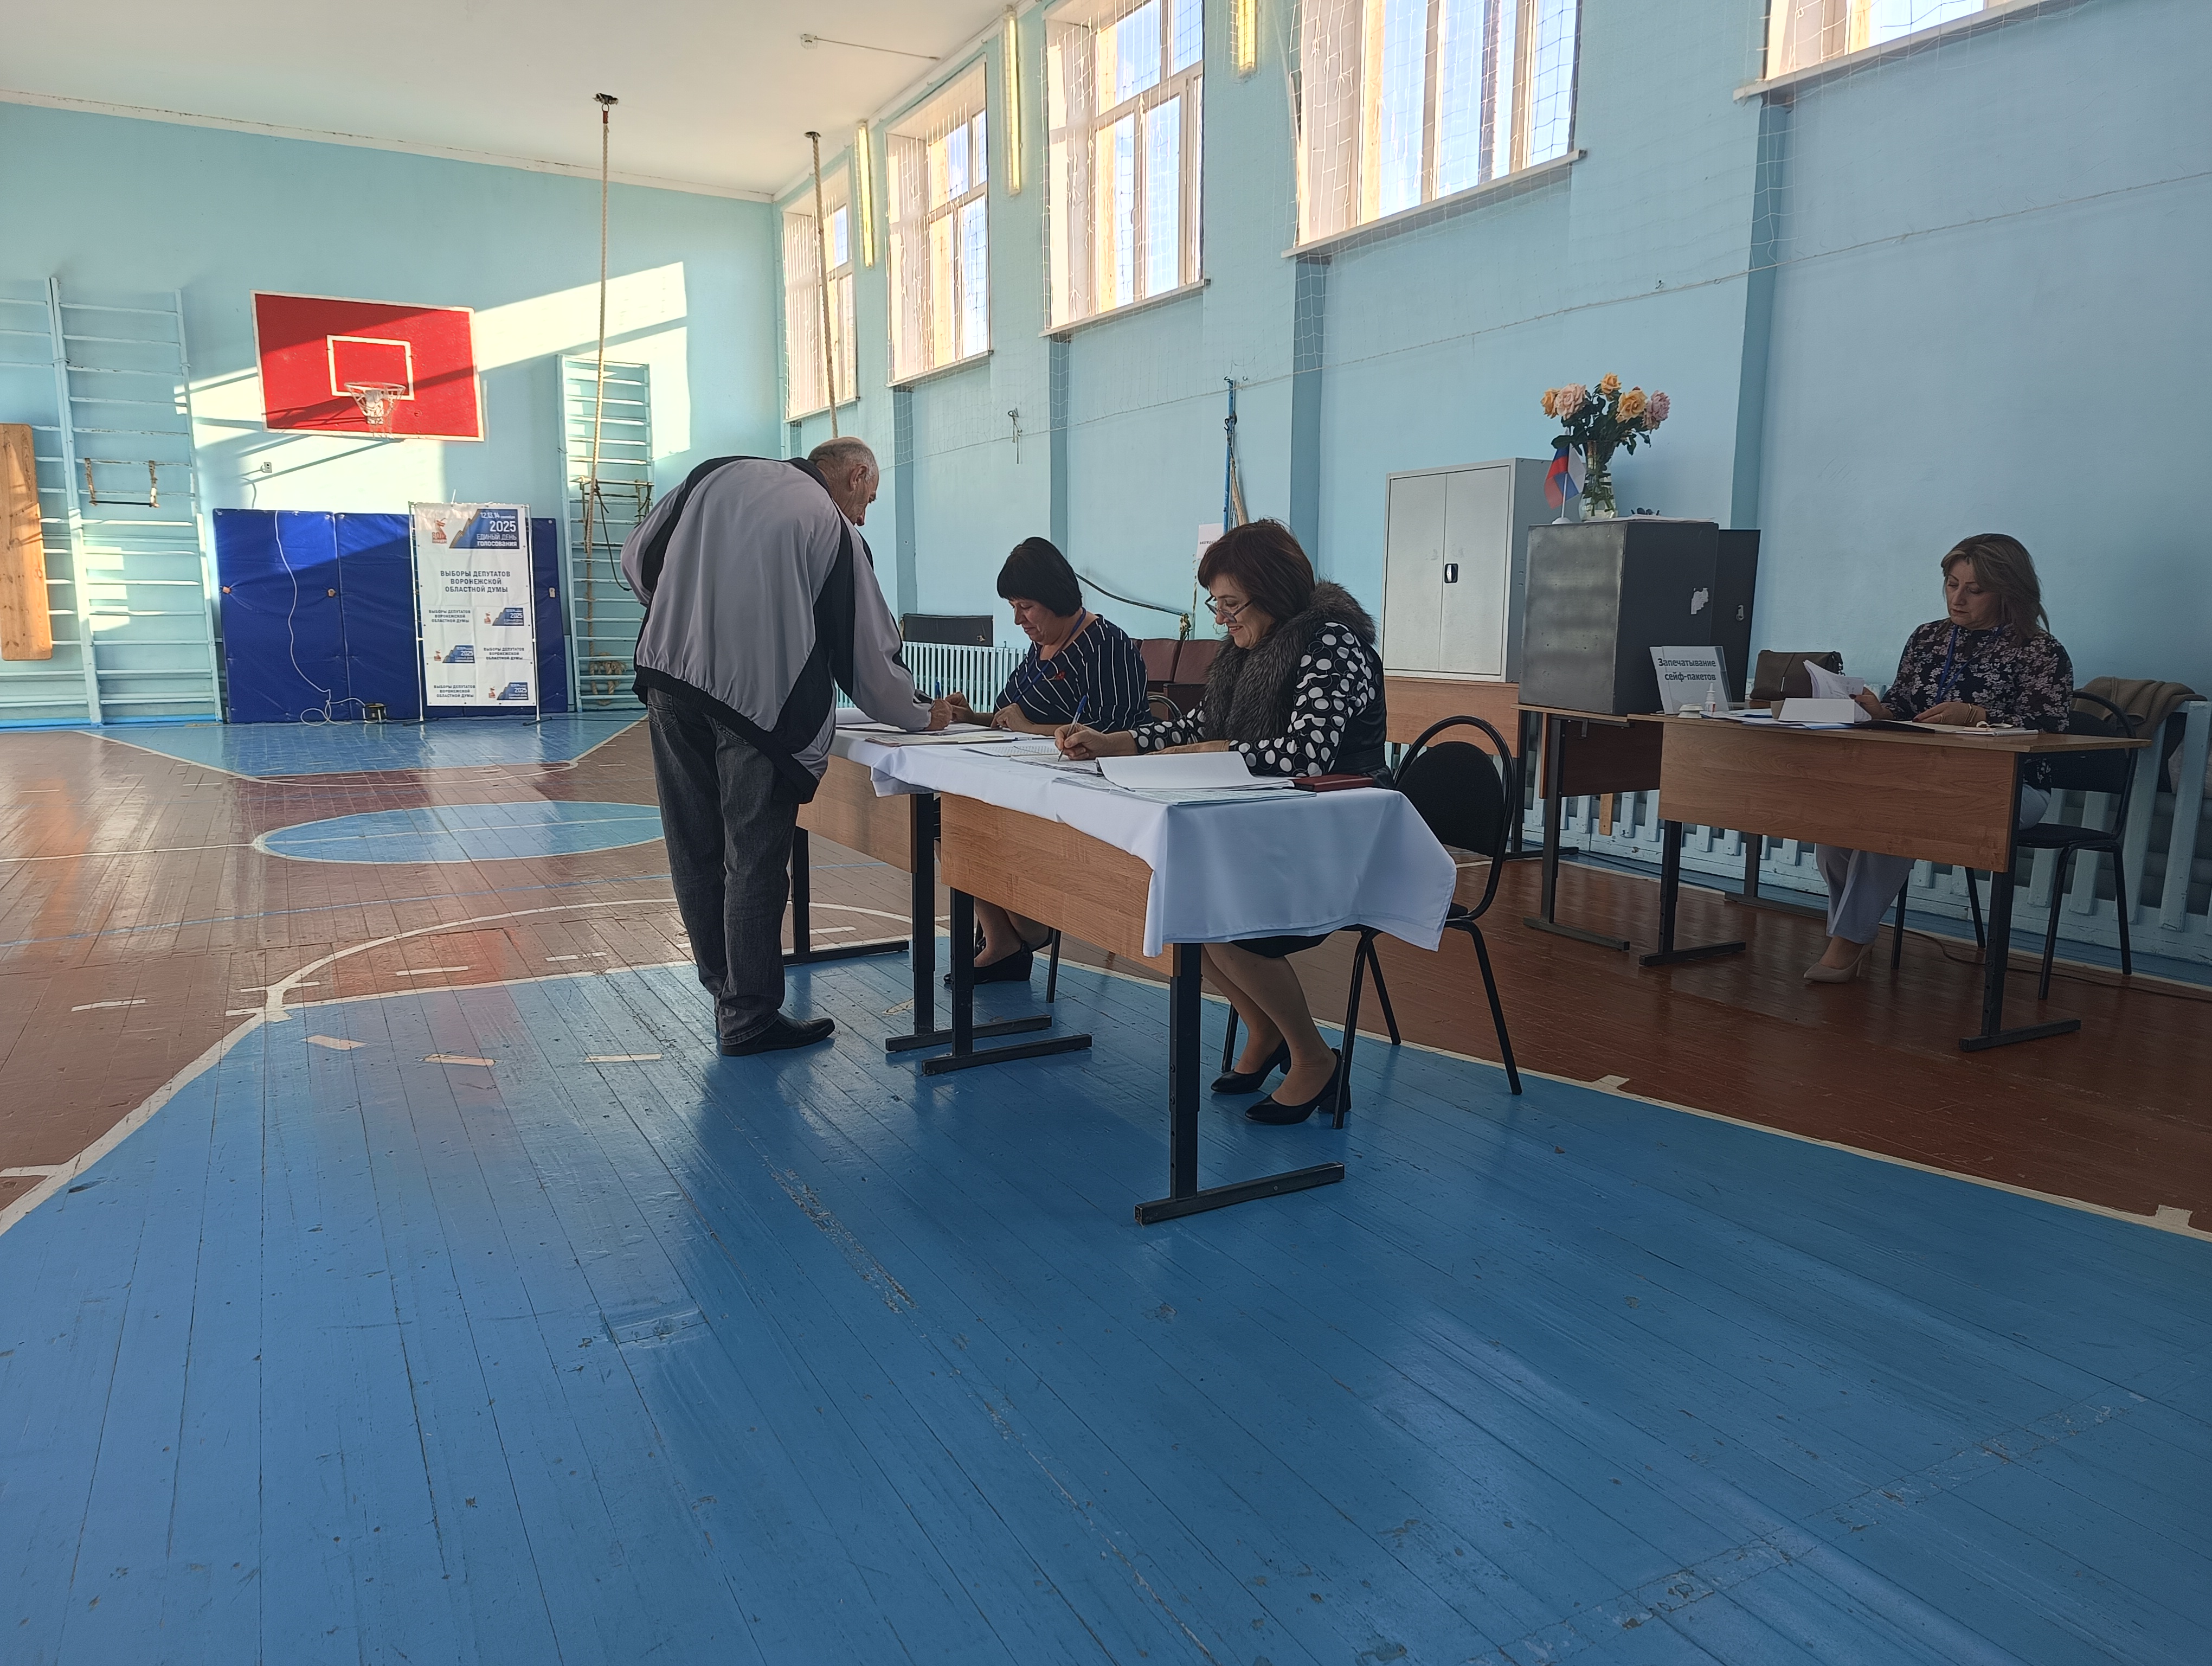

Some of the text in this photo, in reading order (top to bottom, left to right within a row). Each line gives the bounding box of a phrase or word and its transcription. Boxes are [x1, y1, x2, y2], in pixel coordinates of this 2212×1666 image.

[490, 520, 516, 532] 2025
[1657, 658, 1716, 667] Запечатывание
[1664, 671, 1716, 682] сейф-пакетов
